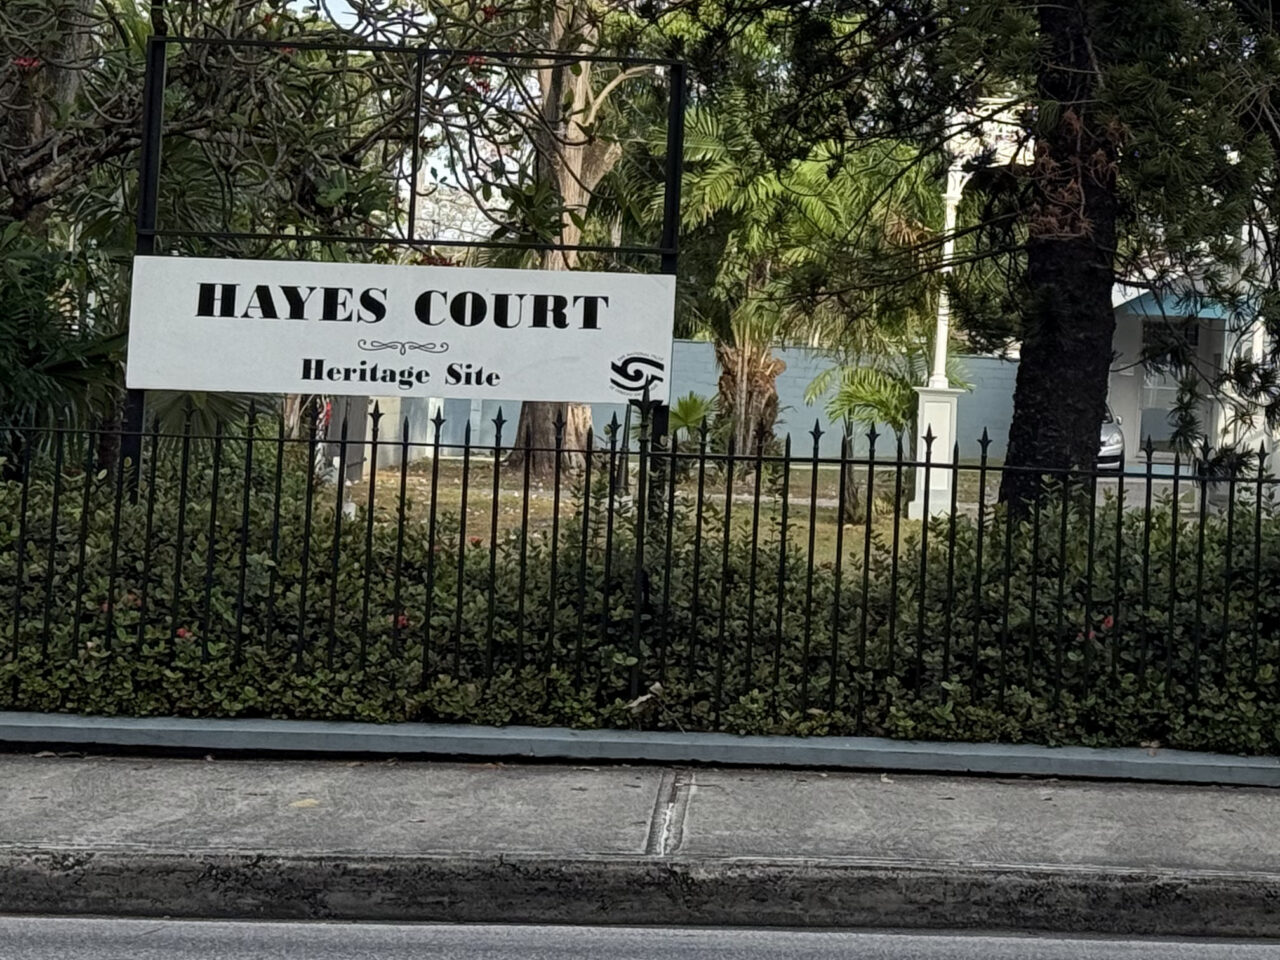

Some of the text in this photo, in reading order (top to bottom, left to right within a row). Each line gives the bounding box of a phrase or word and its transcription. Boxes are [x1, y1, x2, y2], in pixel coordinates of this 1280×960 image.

[196, 283, 609, 330] HAYES COURT
[301, 358, 501, 389] Heritage Site
